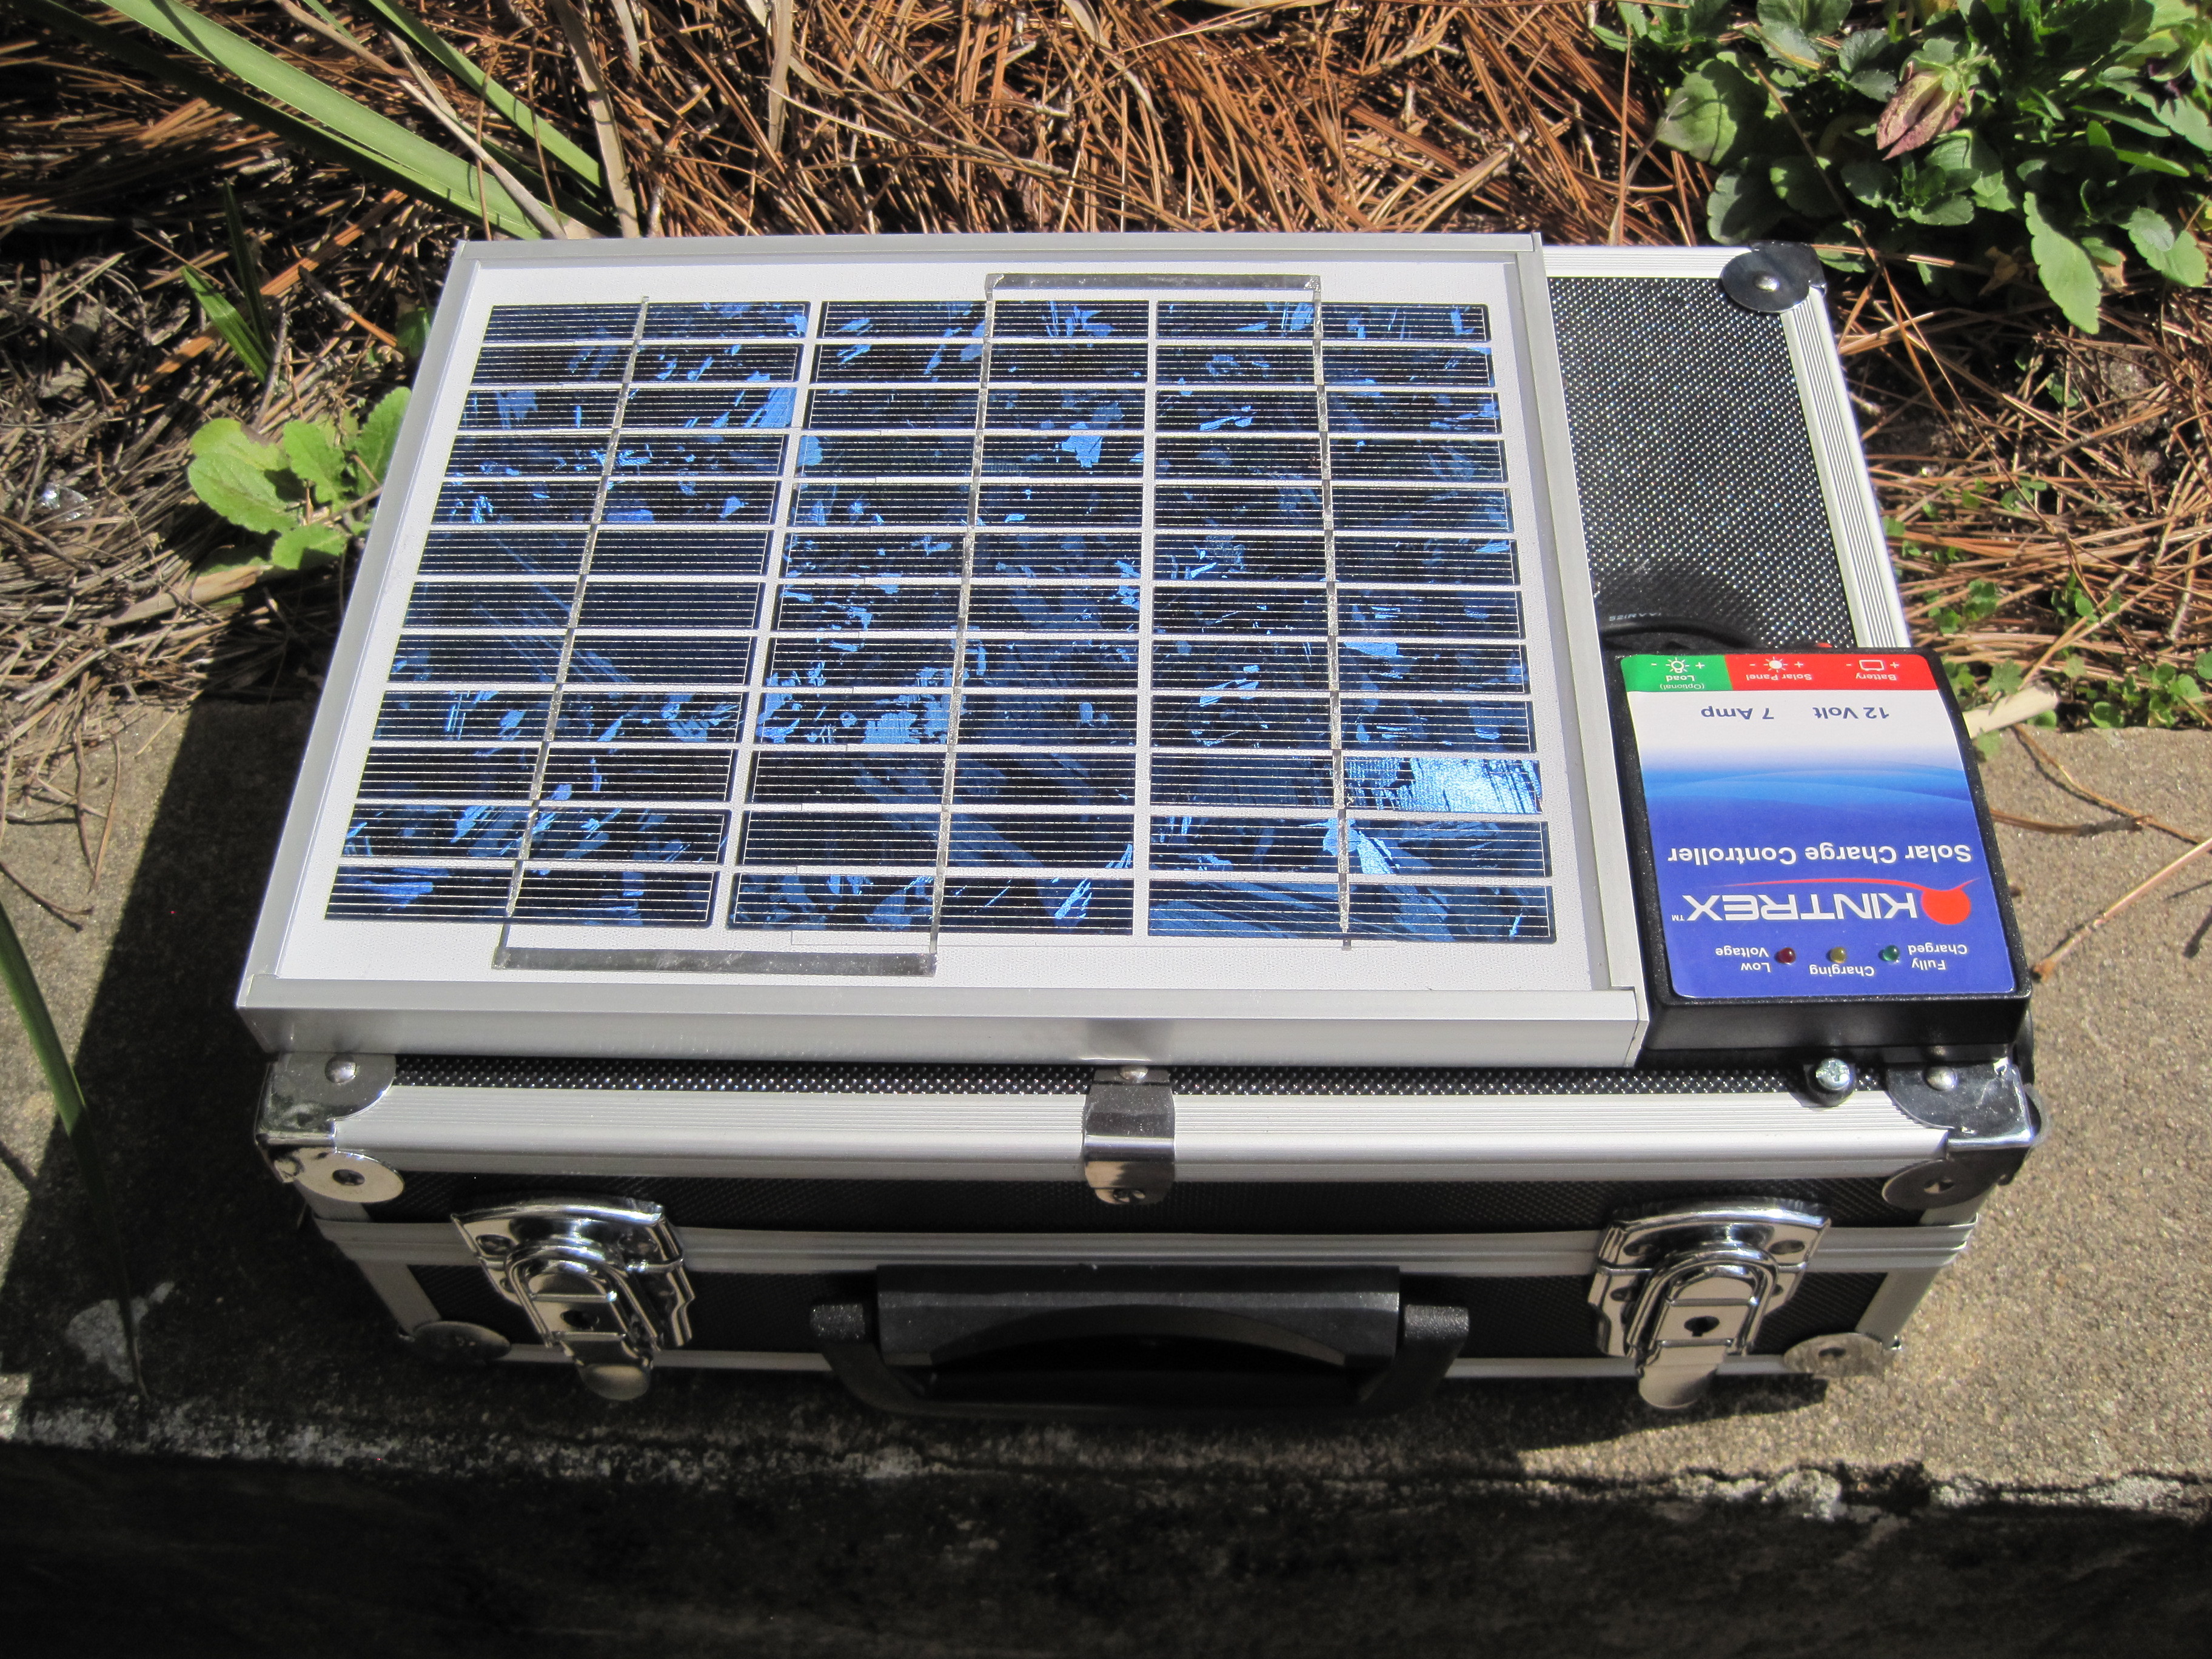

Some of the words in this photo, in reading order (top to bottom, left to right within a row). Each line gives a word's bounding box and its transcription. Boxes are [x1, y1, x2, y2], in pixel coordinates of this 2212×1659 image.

[1700, 706, 1754, 720] Amp
[1762, 707, 1774, 720] 7
[1812, 706, 1859, 720] Volt
[1863, 707, 1889, 719] 12
[1667, 846, 1797, 865] Controller
[1805, 842, 1898, 863] Charge
[1905, 844, 1972, 862] Solar
[1682, 892, 1918, 921] KINTREX
[1715, 945, 1769, 957] Voltage
[1908, 943, 1968, 955] Charged
[1740, 962, 1771, 973] Low
[1809, 964, 1875, 977] Charging
[1911, 958, 1946, 970] Fully
